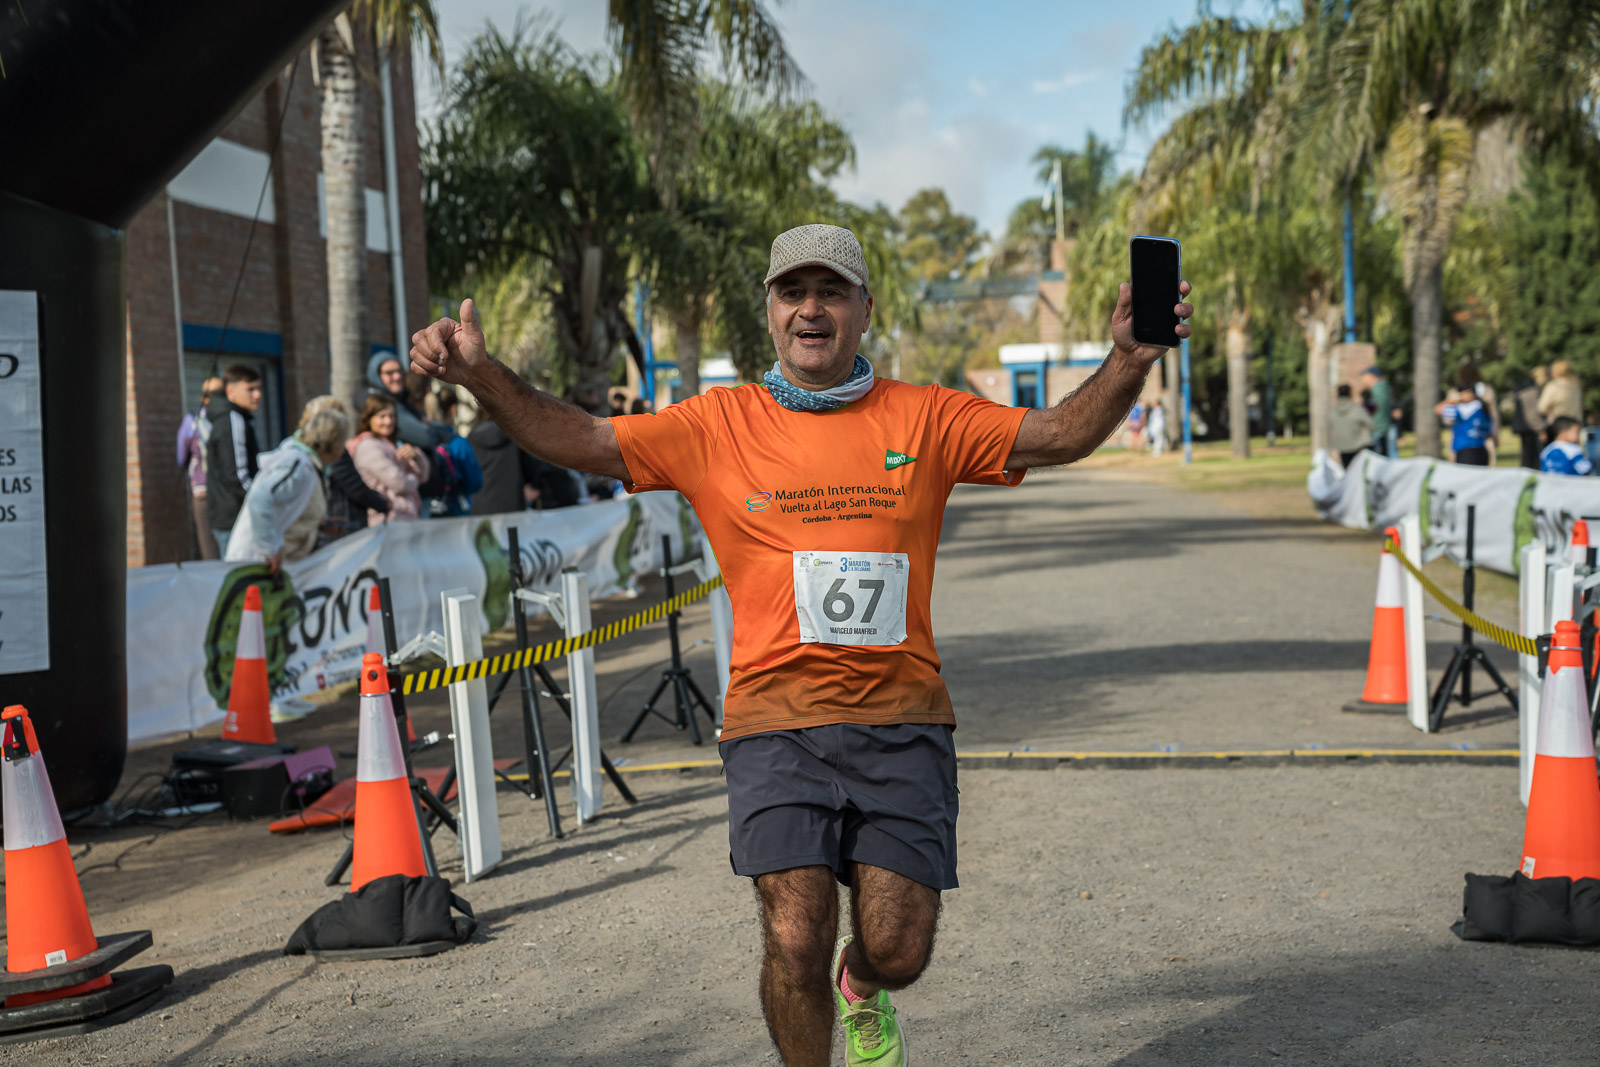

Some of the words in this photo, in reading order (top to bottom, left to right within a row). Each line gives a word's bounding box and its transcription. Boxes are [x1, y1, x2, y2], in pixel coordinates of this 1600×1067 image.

[2, 476, 32, 494] LAS
[775, 487, 824, 500] Maratón
[828, 485, 906, 496] Internacional
[780, 502, 810, 513] Vuelta
[813, 500, 822, 510] al
[824, 500, 846, 511] Lago
[849, 498, 866, 507] San
[869, 497, 896, 509] Roque
[802, 515, 831, 523] Córdoba
[837, 512, 872, 521] Argentina
[822, 578, 885, 623] 67
[829, 627, 853, 635] MARCELO
